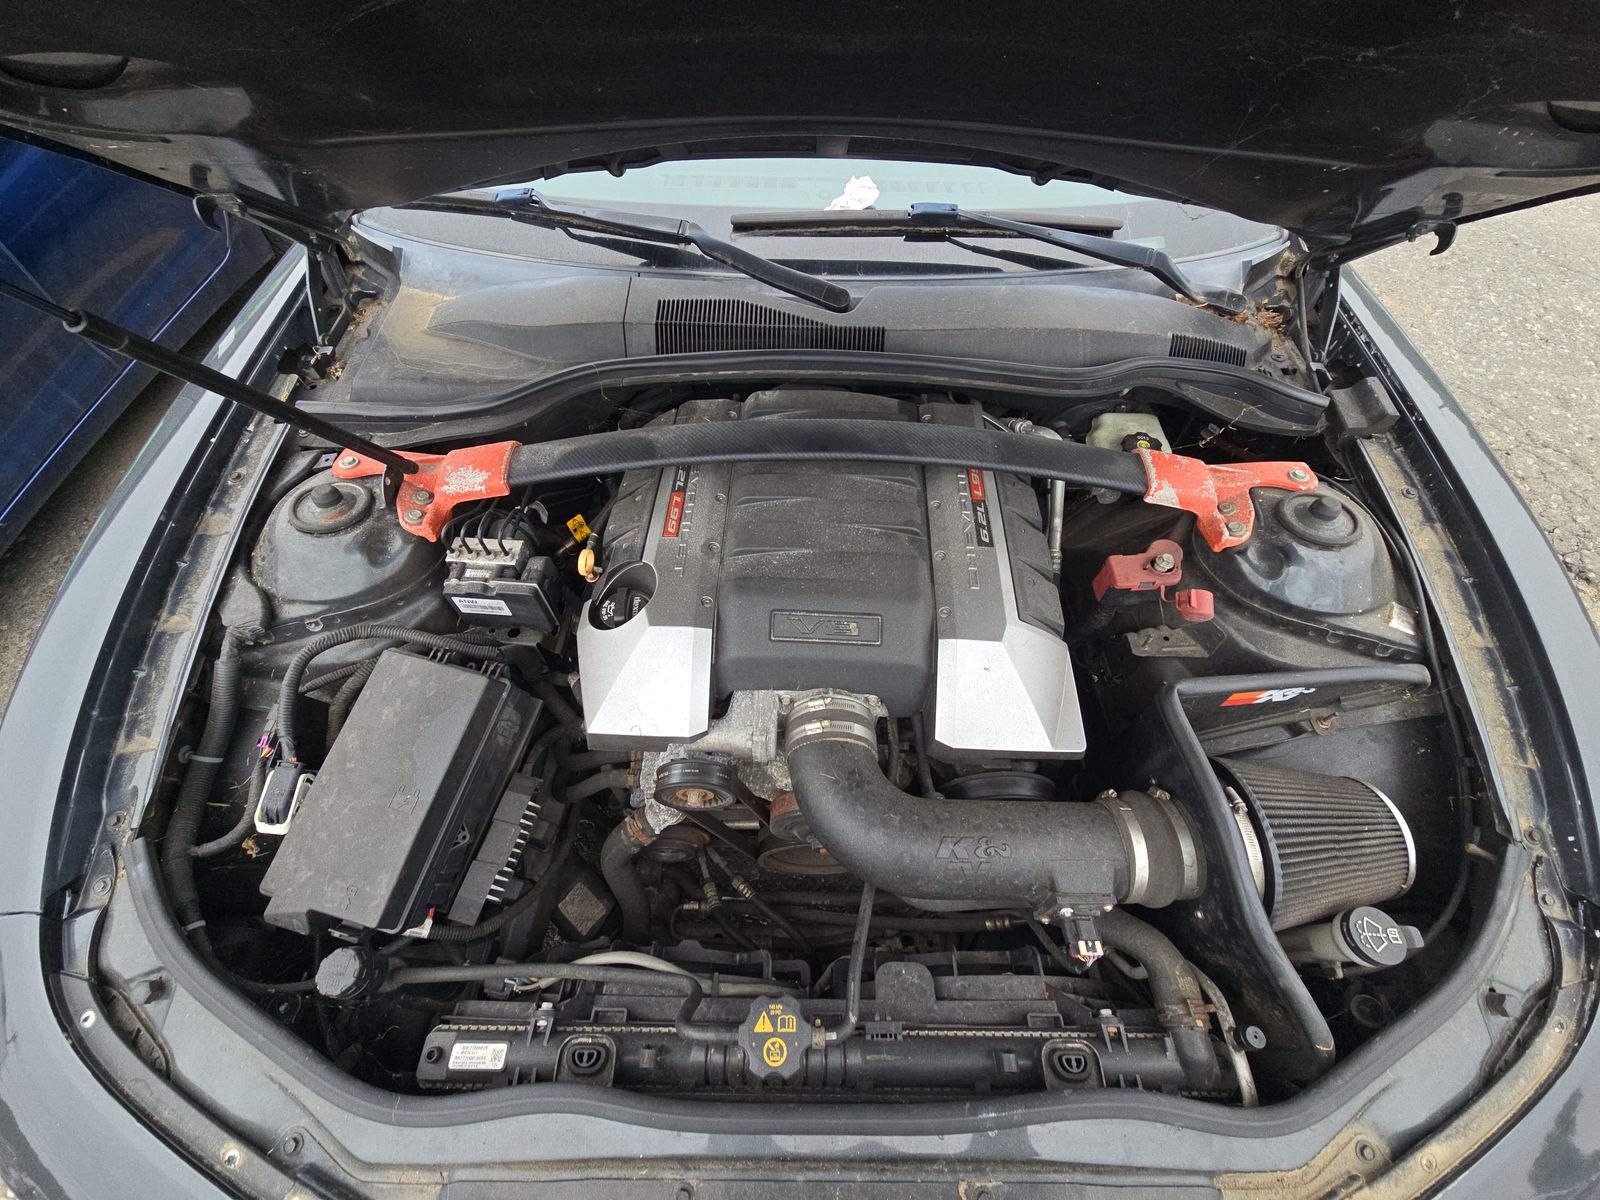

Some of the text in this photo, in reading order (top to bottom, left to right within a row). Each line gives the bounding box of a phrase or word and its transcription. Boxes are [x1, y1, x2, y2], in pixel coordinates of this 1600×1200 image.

[667, 465, 687, 534] .2L L99
[673, 465, 701, 578] EVROLET
[976, 502, 990, 543] 6.2L
